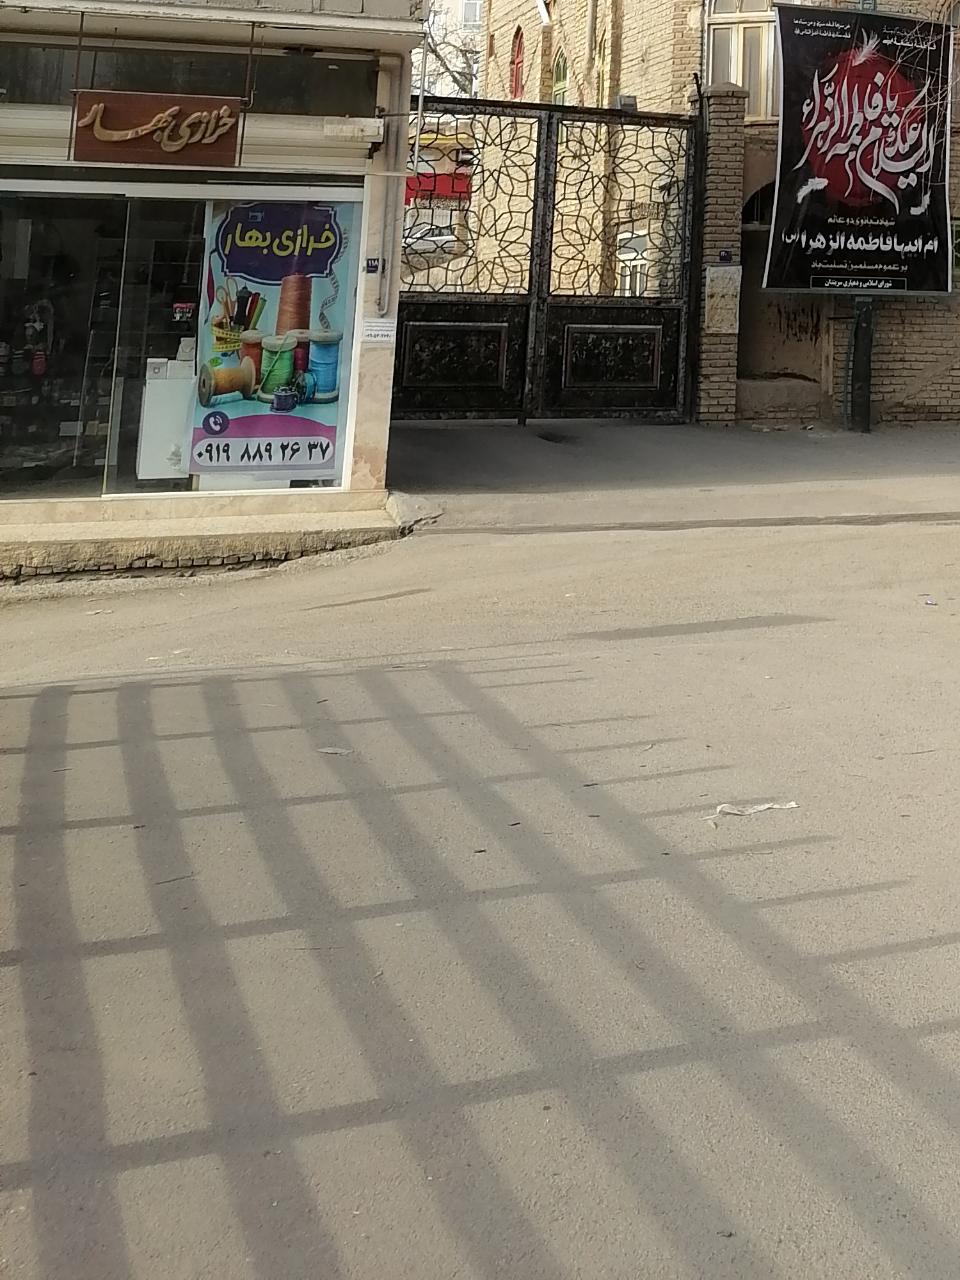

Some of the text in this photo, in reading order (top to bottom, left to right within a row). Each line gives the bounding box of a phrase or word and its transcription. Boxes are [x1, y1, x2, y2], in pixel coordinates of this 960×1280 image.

[160, 104, 237, 153] خرازی
[224, 222, 336, 257] خرازی بهار
[800, 229, 846, 256] الزهرا
[846, 230, 893, 252] فاطمه
